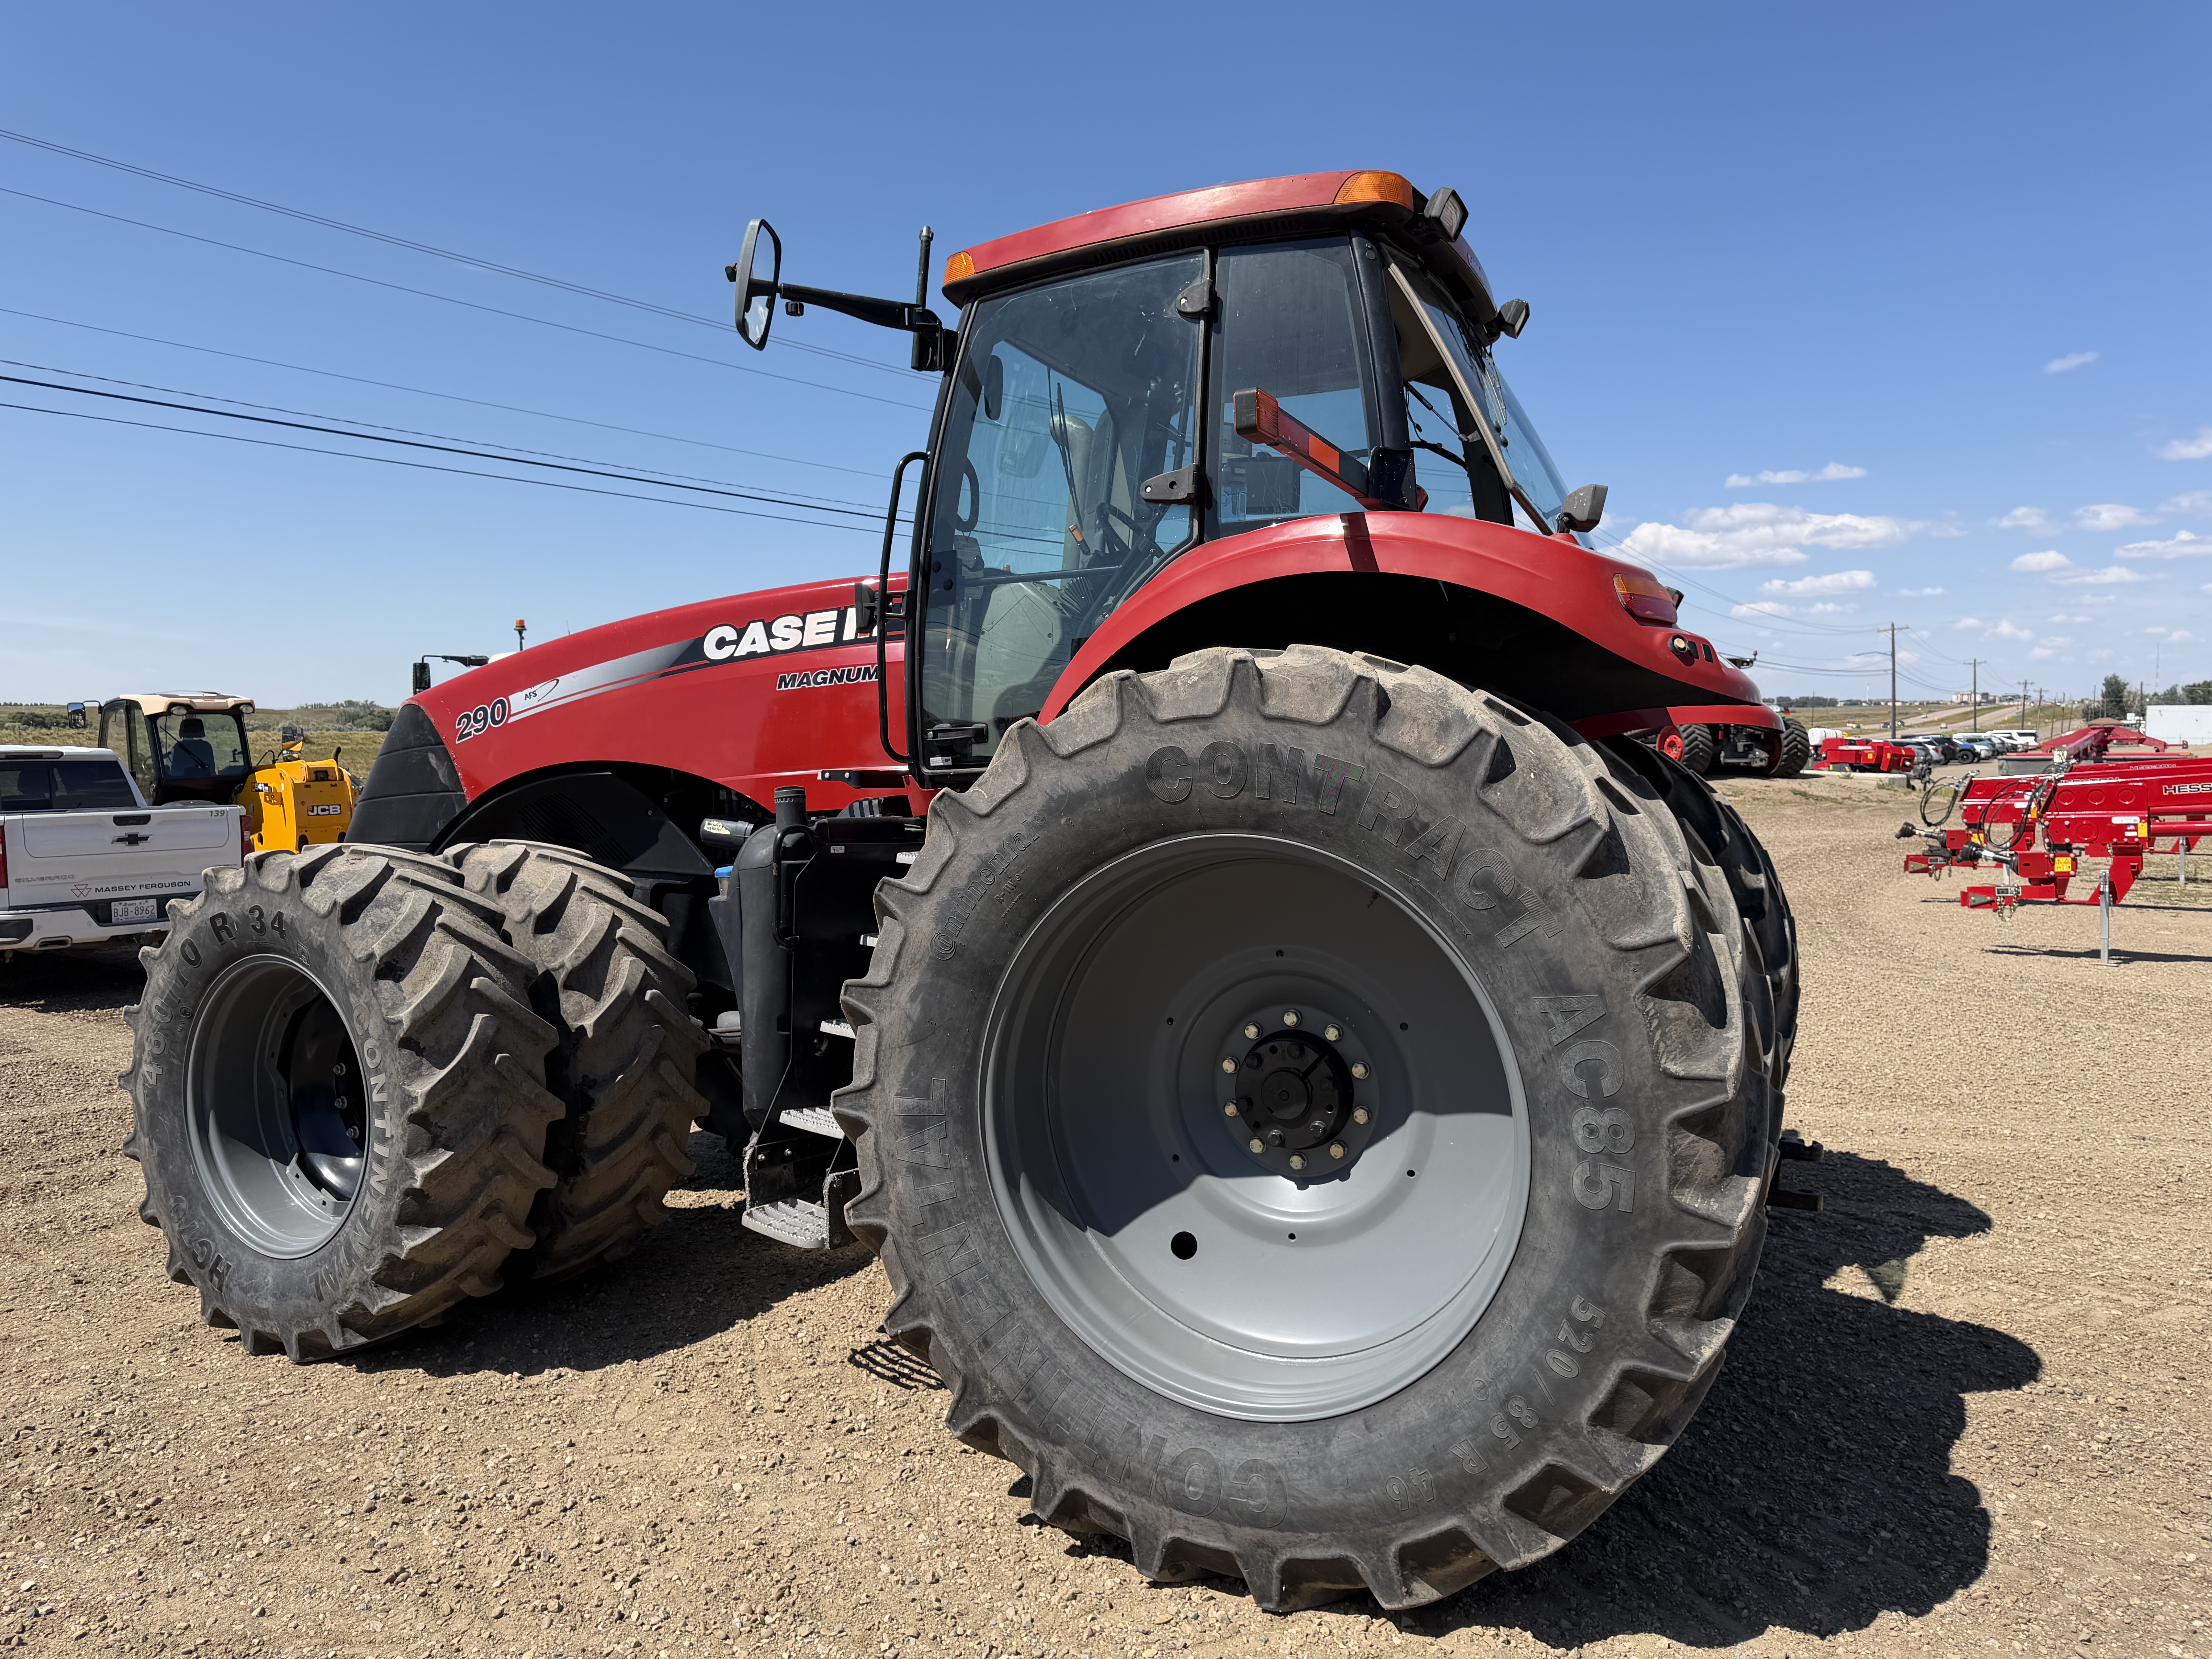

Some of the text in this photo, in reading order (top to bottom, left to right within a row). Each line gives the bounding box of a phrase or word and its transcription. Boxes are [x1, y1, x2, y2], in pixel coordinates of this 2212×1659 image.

[704, 610, 838, 660] CASE
[524, 690, 537, 701] AFS
[776, 665, 879, 690] MAGNUM
[456, 697, 508, 744] 290
[308, 805, 341, 816] JCB
[95, 881, 191, 893] MASSEY FERGUSON
[114, 905, 155, 917] BJB-8962
[209, 912, 236, 945] R
[249, 905, 286, 942] 34
[1145, 740, 1636, 1214] CONTRACT AC85
[893, 1078, 1288, 1528] CONTINENTAL
[1386, 1295, 1606, 1511] 520/85 R 46
